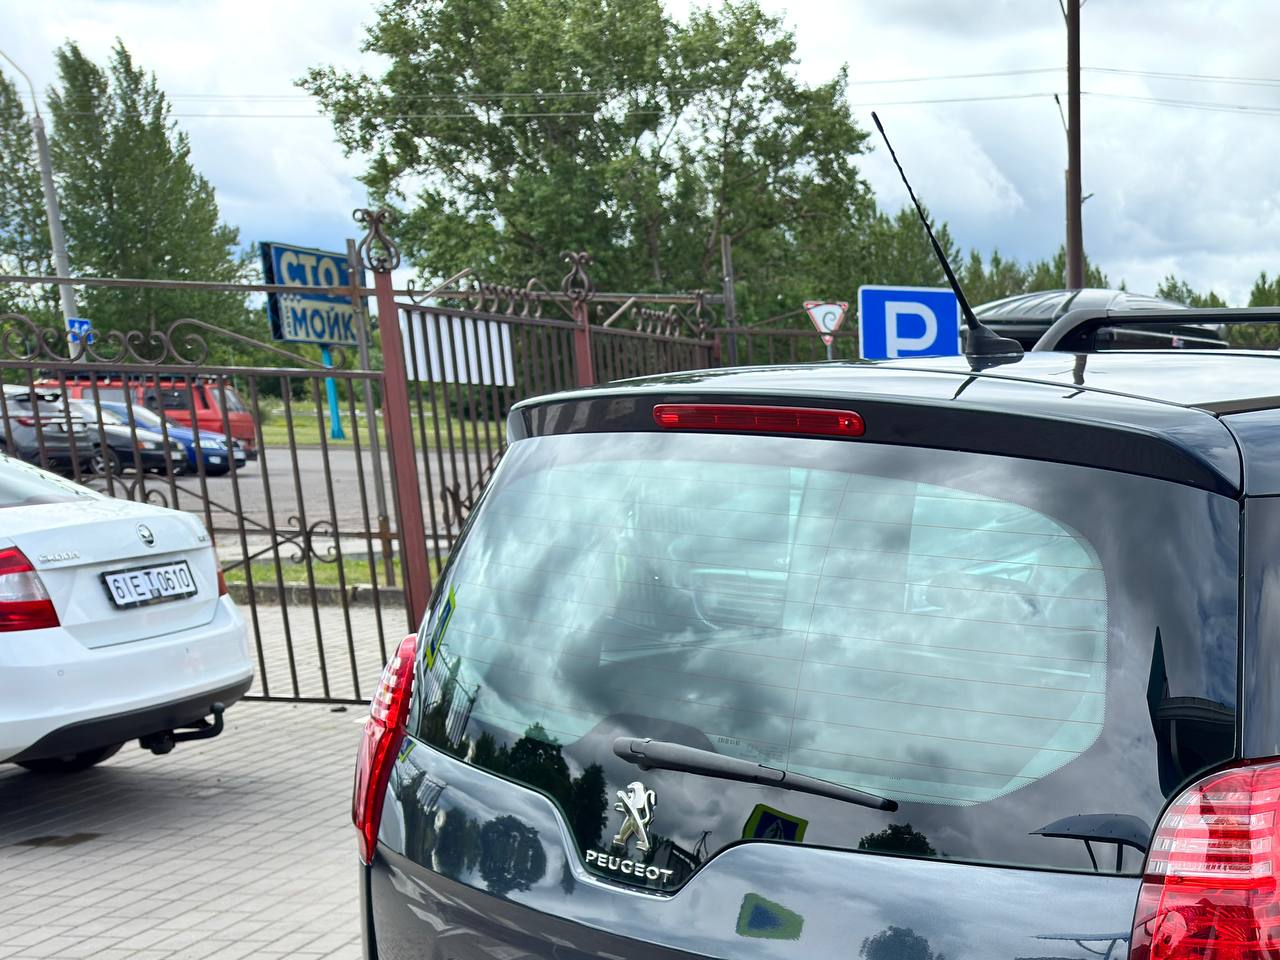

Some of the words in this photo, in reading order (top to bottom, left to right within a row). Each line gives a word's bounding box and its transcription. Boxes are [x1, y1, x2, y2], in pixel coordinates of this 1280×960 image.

[281, 251, 340, 287] СТО
[291, 303, 358, 341] МОЙК
[885, 301, 938, 358] P
[585, 849, 674, 883] PEUGEOT
